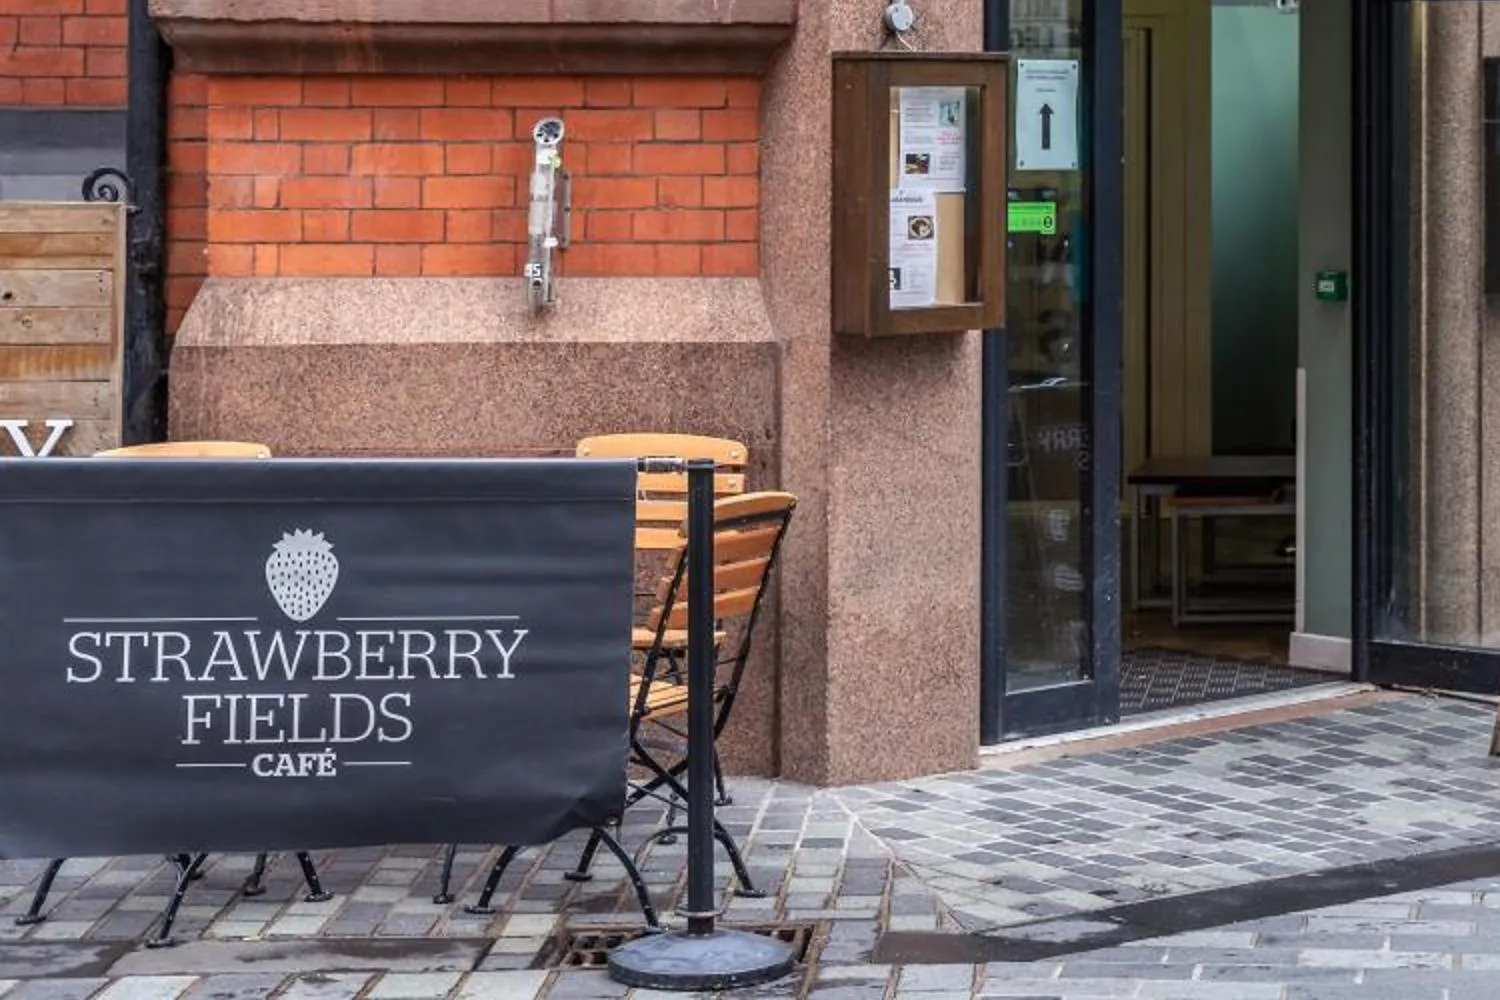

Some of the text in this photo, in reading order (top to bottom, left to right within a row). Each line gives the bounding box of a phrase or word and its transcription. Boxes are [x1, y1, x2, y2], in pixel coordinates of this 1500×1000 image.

[65, 629, 529, 684] STRAWBERRY
[181, 692, 414, 745] FIELDS
[252, 748, 337, 778] CAFÉ
